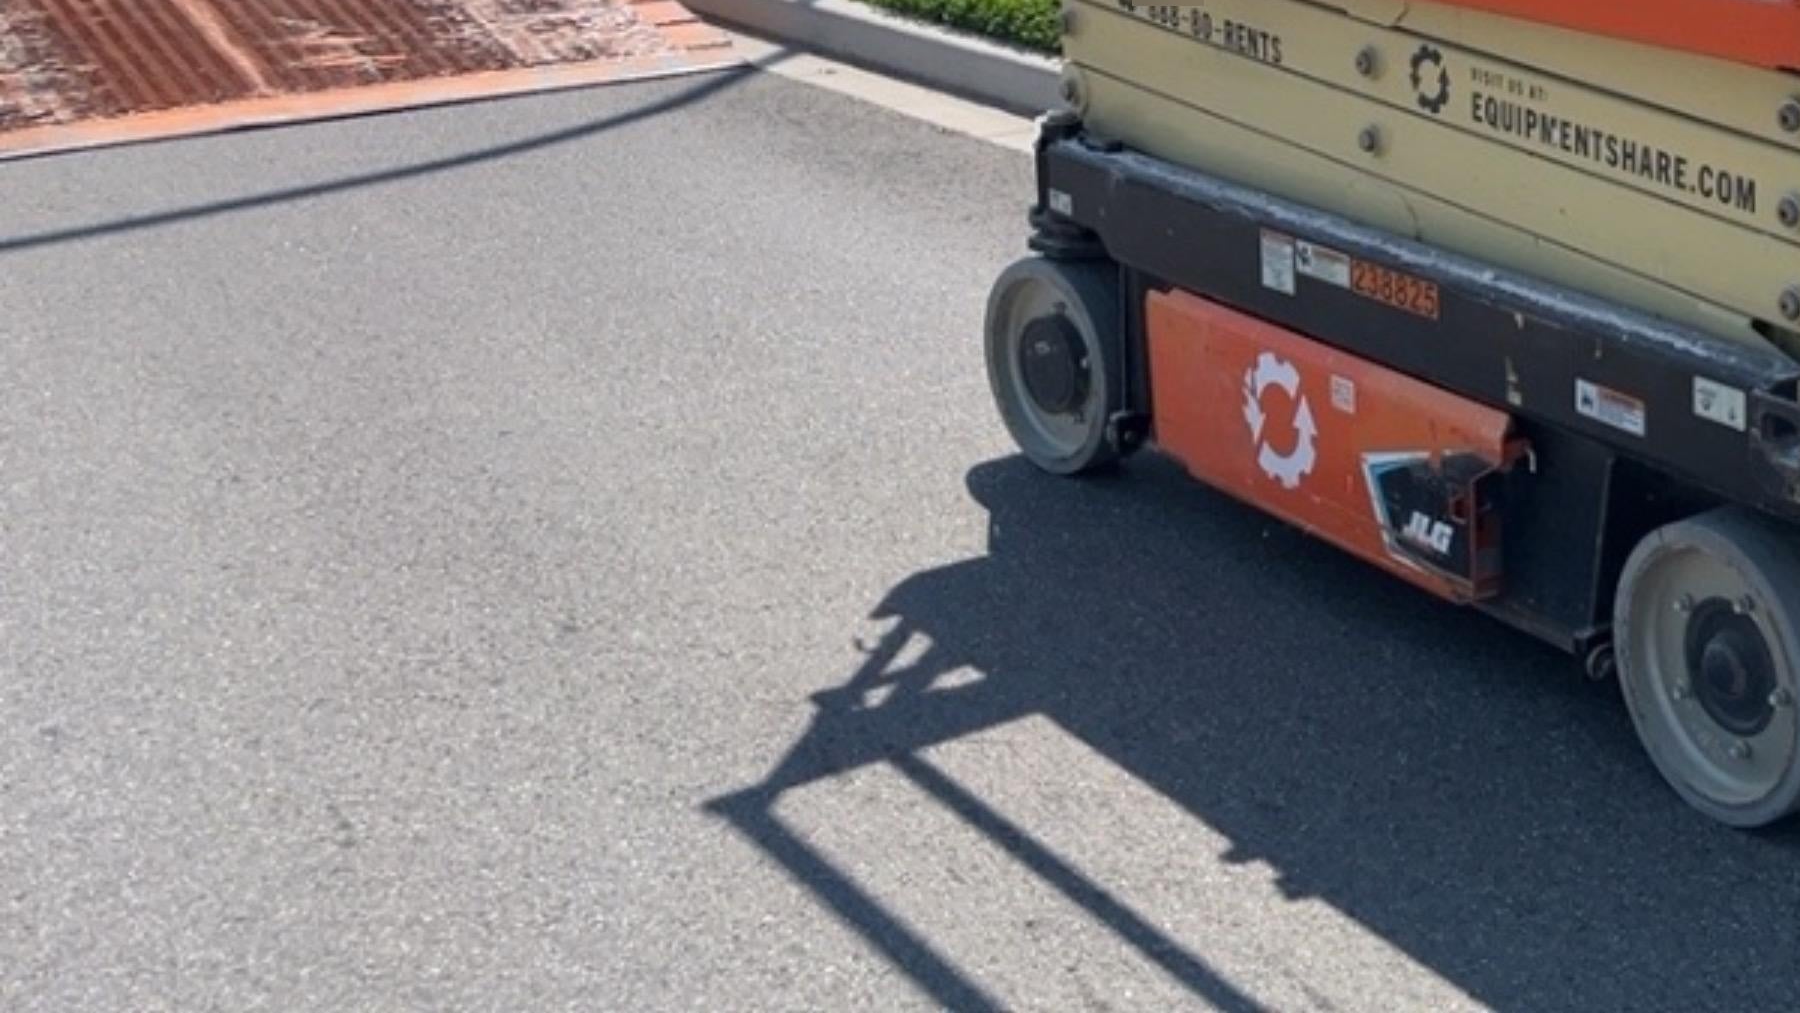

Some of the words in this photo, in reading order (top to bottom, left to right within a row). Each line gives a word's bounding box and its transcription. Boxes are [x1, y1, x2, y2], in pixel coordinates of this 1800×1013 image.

[1471, 91, 1758, 213] EQUIPMENTSHARE.COM
[1353, 259, 1438, 318] 238825
[1402, 510, 1453, 555] JLG
